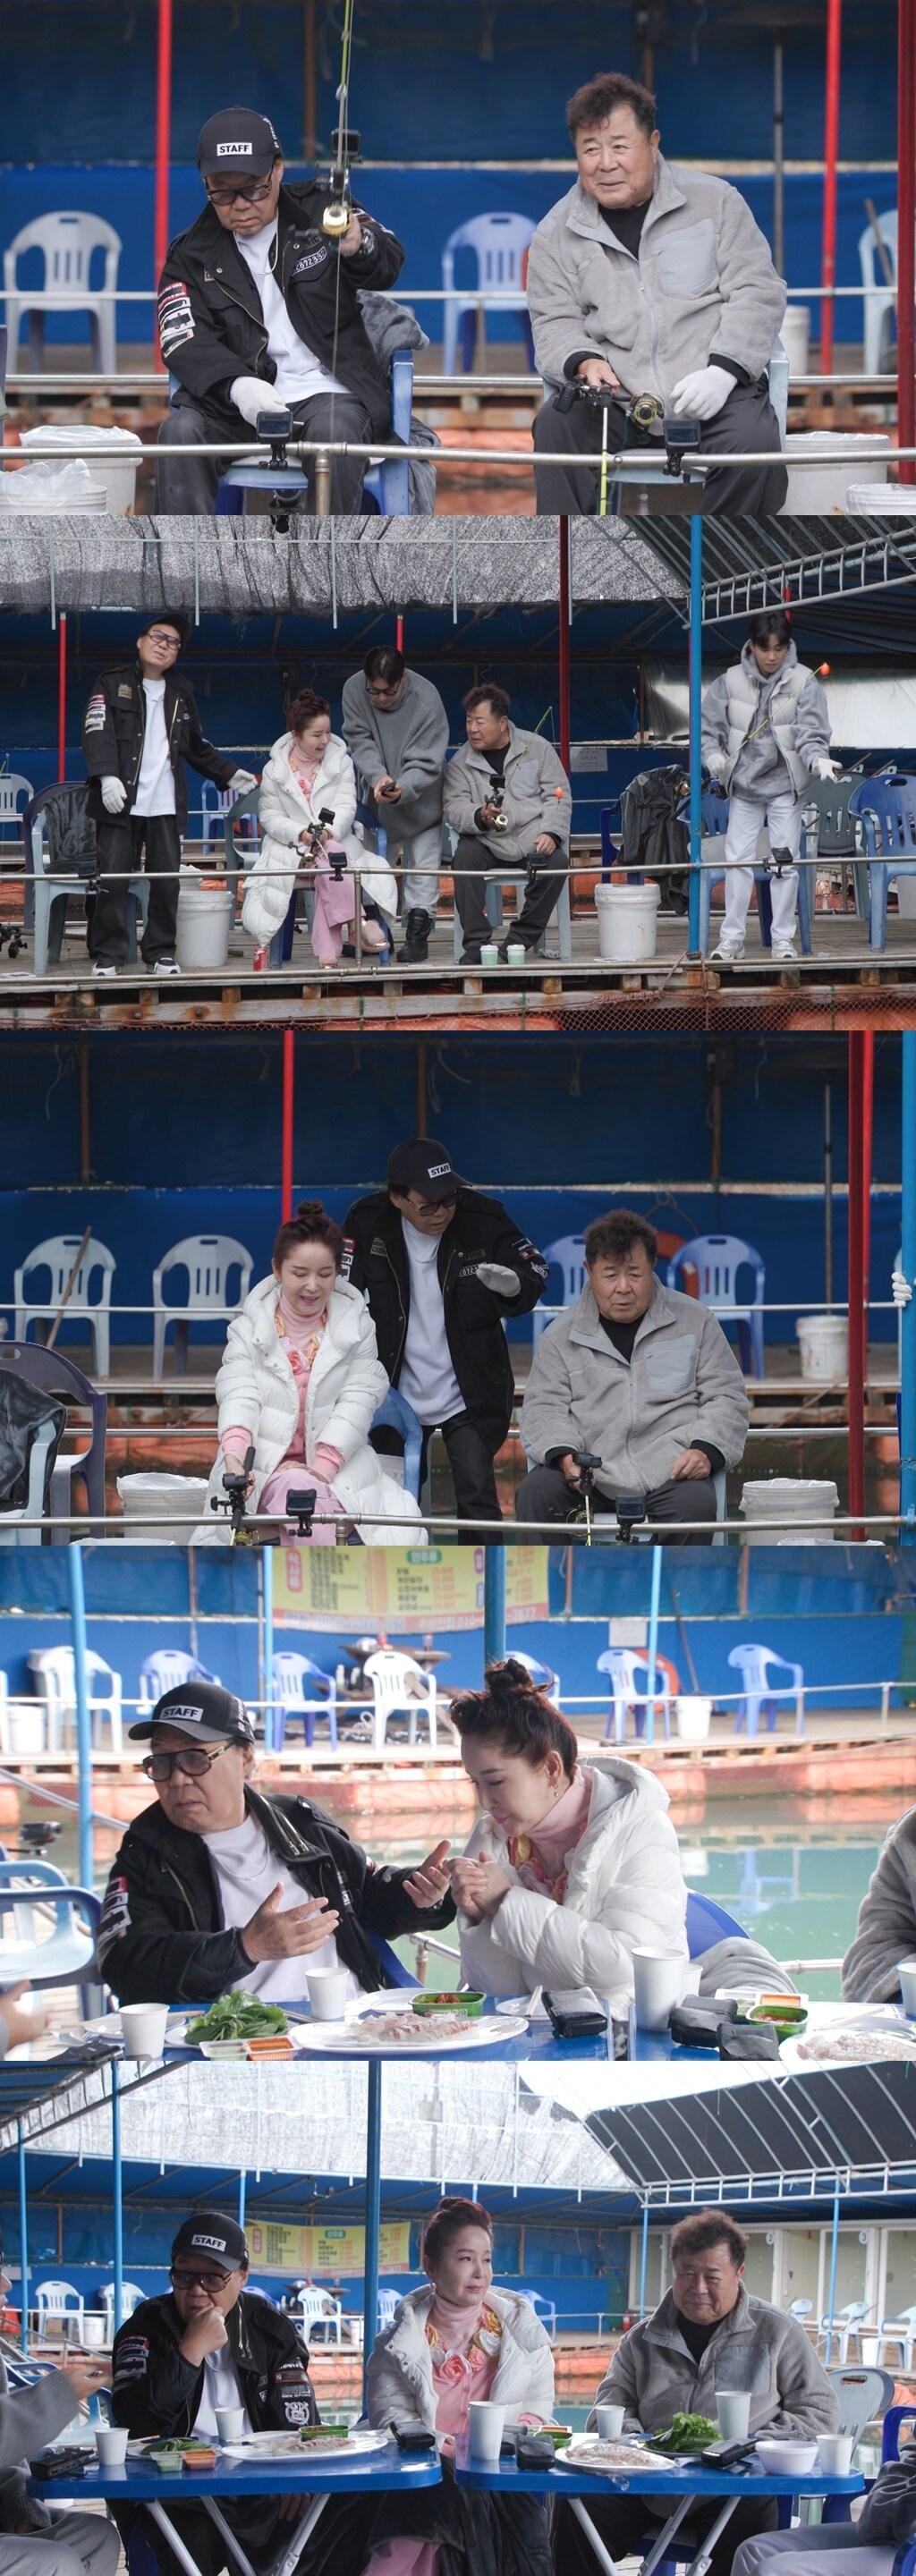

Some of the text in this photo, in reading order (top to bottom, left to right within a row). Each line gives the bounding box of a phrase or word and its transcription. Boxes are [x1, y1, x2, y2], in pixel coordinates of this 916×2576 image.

[219, 144, 250, 153] STAFF
[163, 1707, 199, 1717] STAFF
[194, 2236, 224, 2248] STAFF
